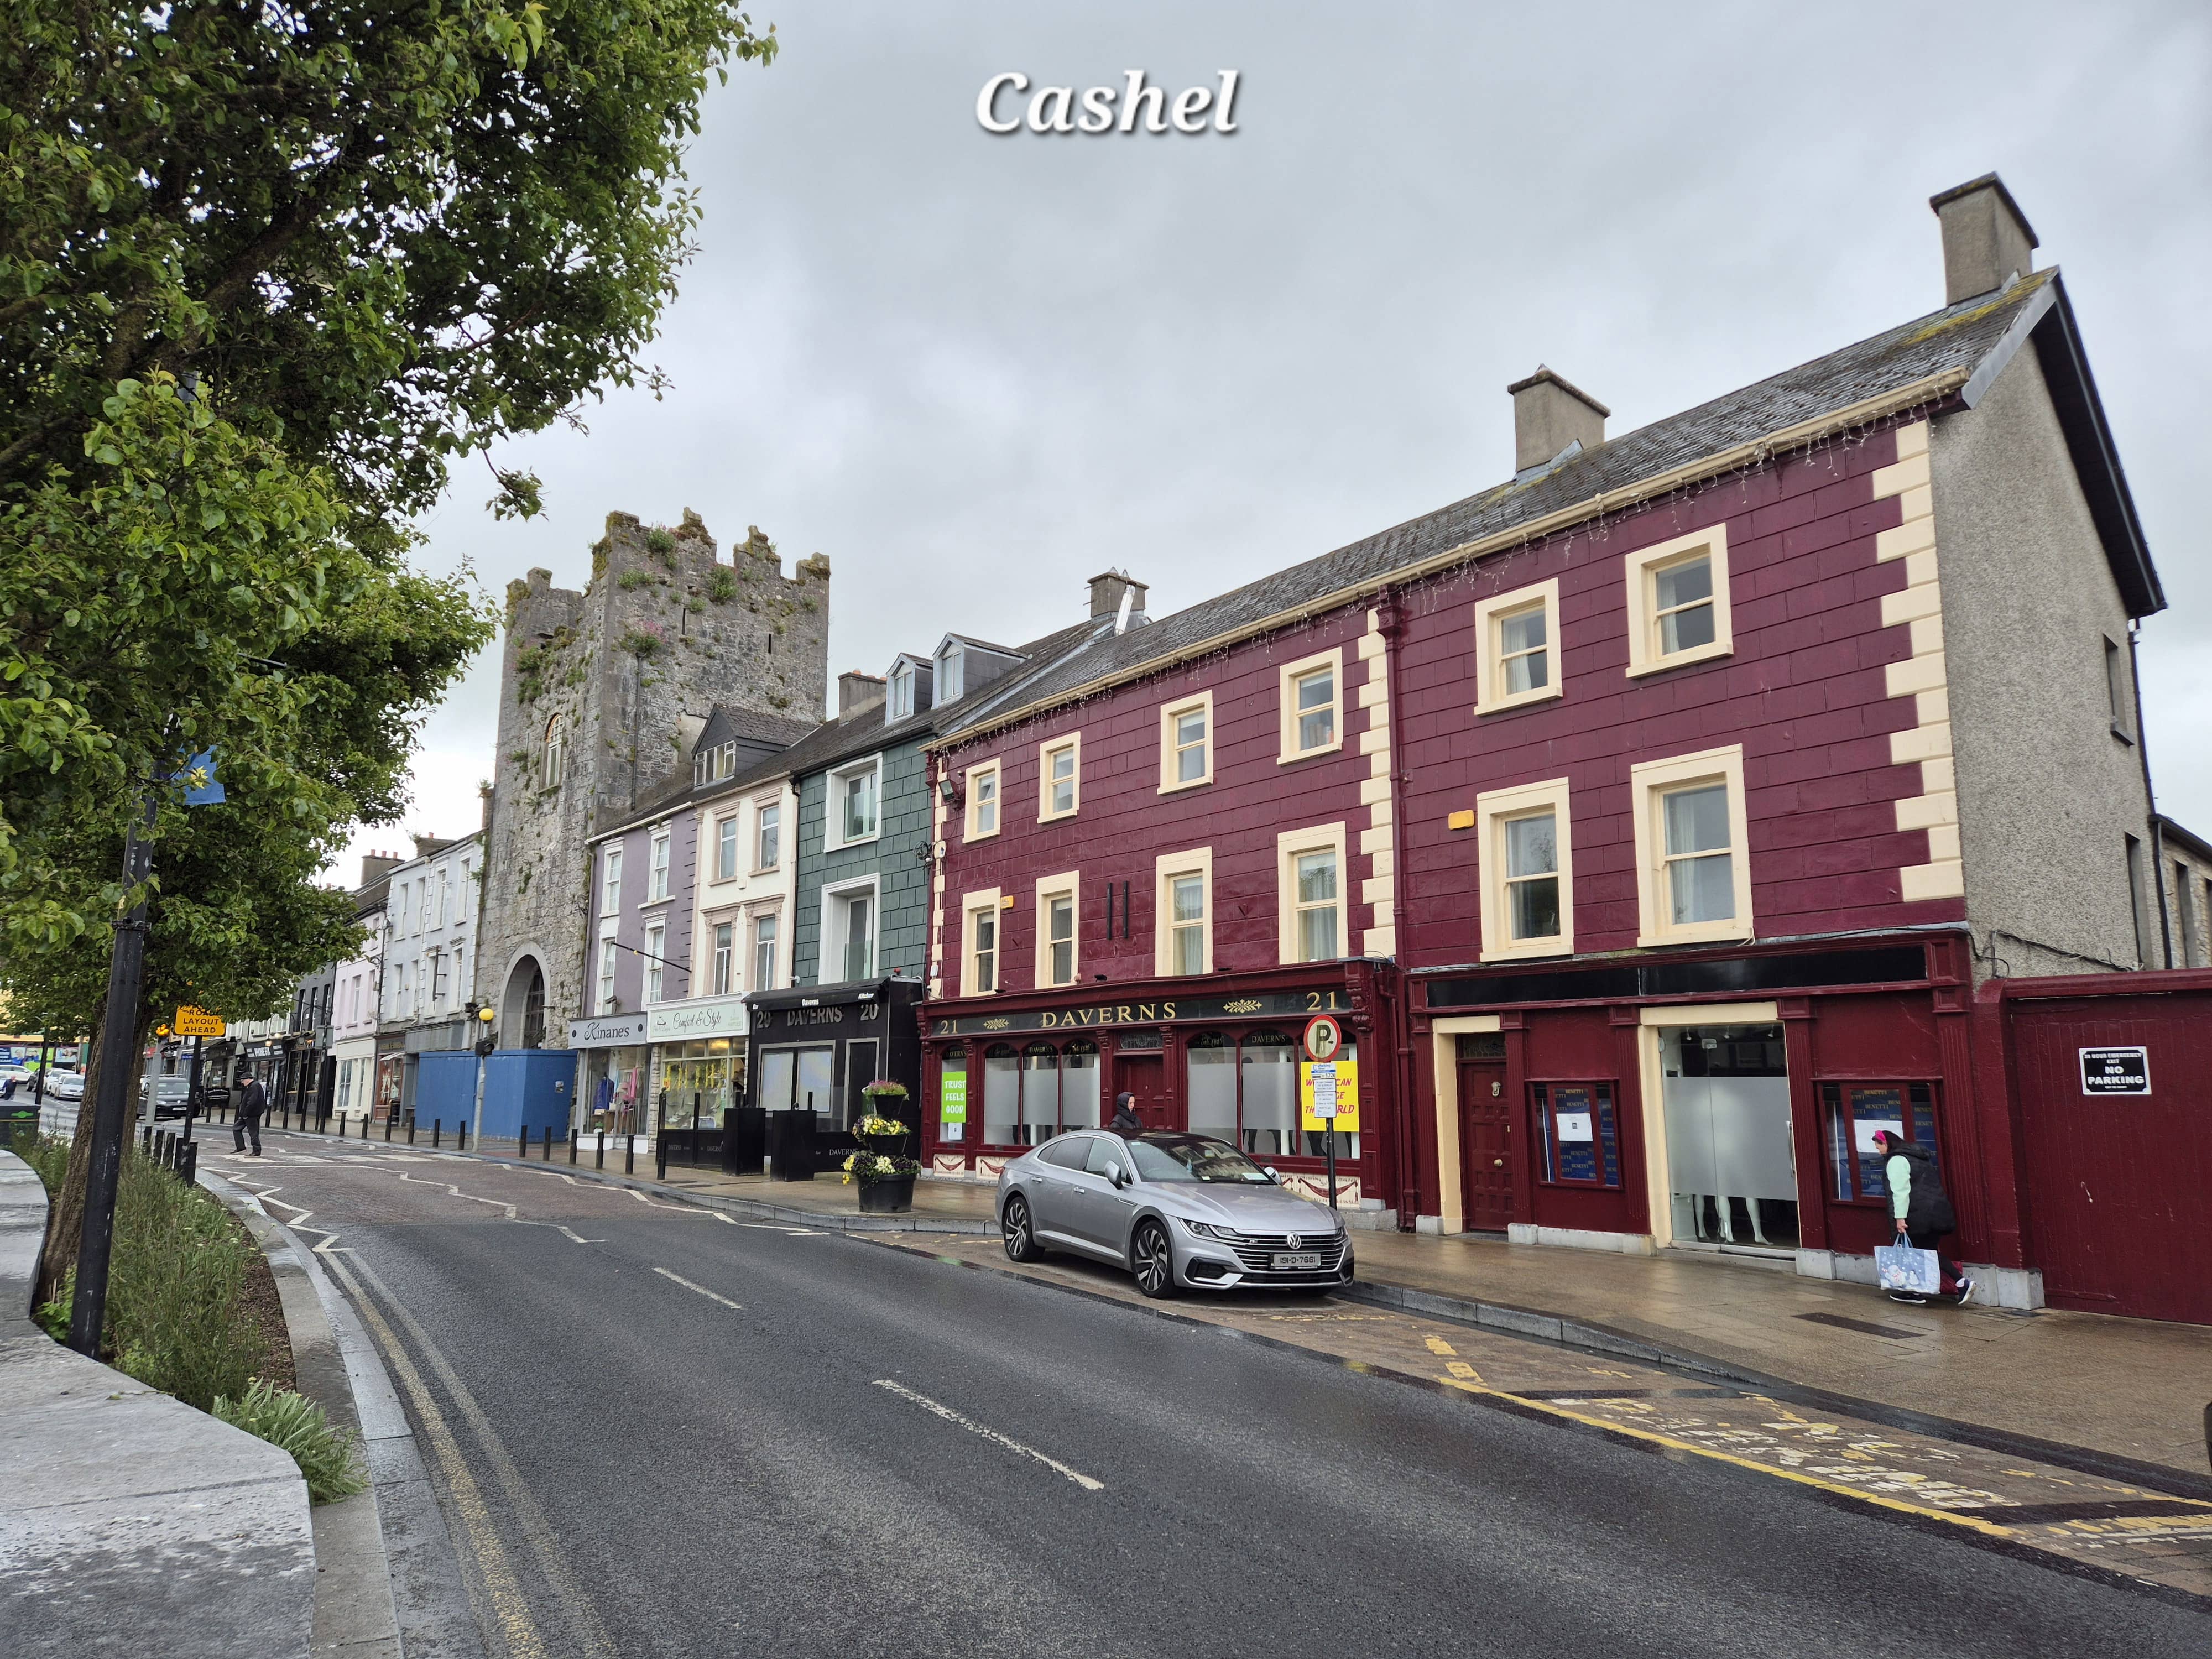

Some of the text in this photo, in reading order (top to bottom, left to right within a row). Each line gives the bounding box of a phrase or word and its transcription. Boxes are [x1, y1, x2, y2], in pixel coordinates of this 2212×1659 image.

[756, 1010, 771, 1029] 20
[787, 1006, 843, 1026] DAVERNS
[860, 1004, 879, 1021] 20
[941, 990, 1338, 1034] 21 DAVERNS 21
[673, 1013, 695, 1033] Comfort
[696, 1010, 703, 1026] &
[703, 1008, 722, 1030] Style
[584, 1022, 629, 1040] Kinane's
[2105, 1066, 2124, 1074] NO
[1336, 1078, 1353, 1087] CAN
[2088, 1075, 2145, 1084] PARKING
[945, 1080, 967, 1089] TRUST
[945, 1092, 964, 1102] FEELS
[946, 1105, 964, 1114] GOOD
[1305, 1105, 1315, 1114] TH
[1336, 1104, 1355, 1114] RLD
